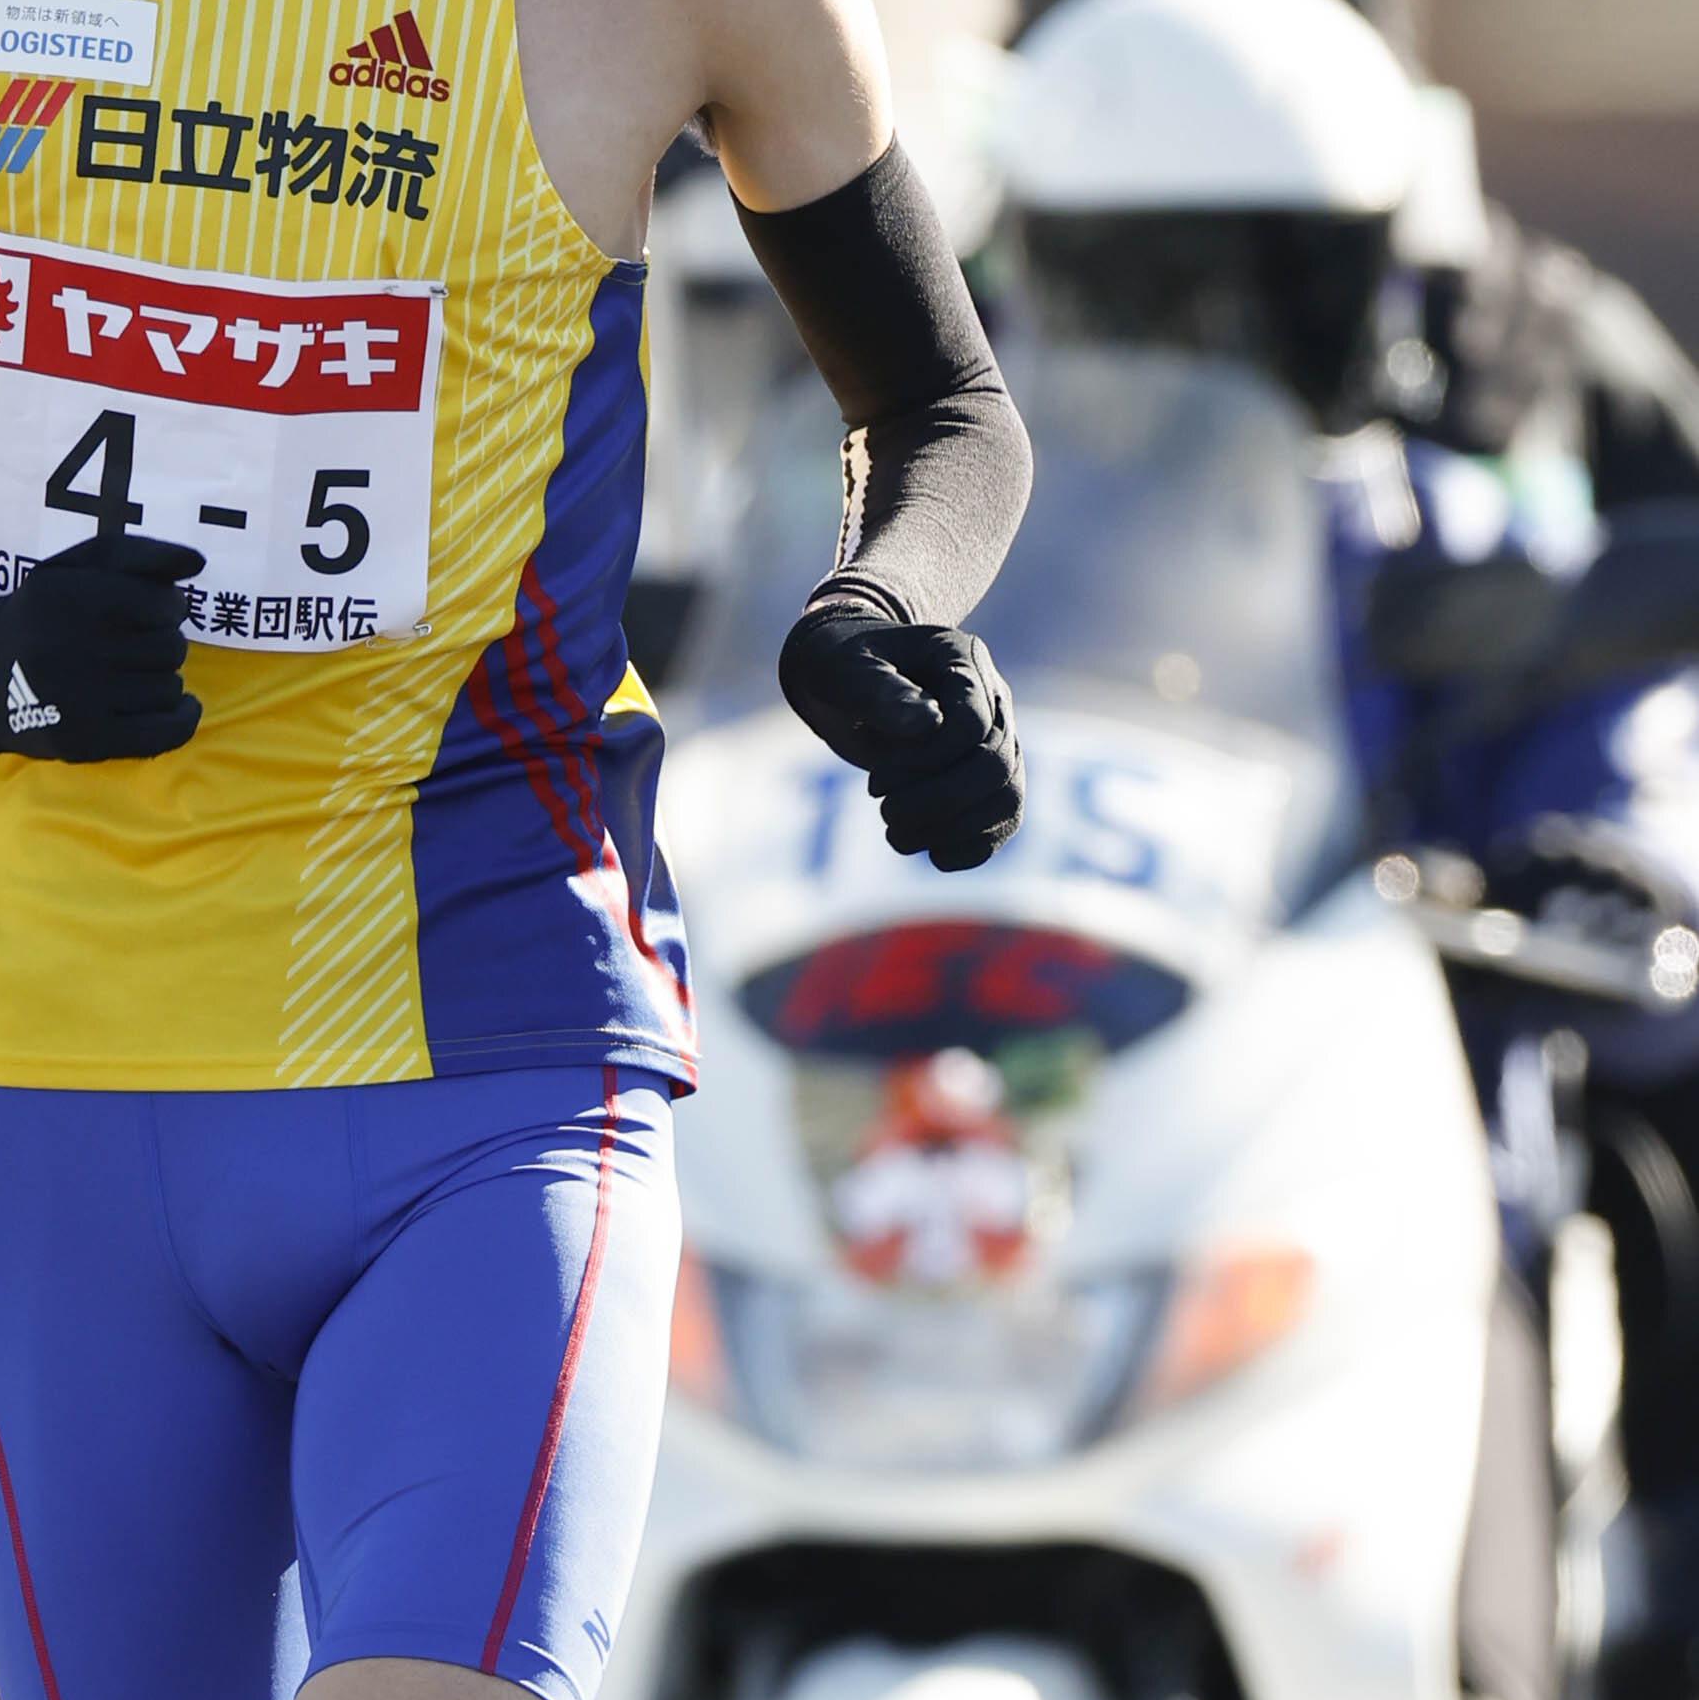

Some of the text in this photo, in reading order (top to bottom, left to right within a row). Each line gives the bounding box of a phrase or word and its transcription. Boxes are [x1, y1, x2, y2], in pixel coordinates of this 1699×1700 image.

[4, 4, 121, 28] 物流は新領域へ
[328, 55, 450, 102] adidas
[76, 93, 440, 221] 日立物流
[51, 286, 399, 389] ヤマザキ
